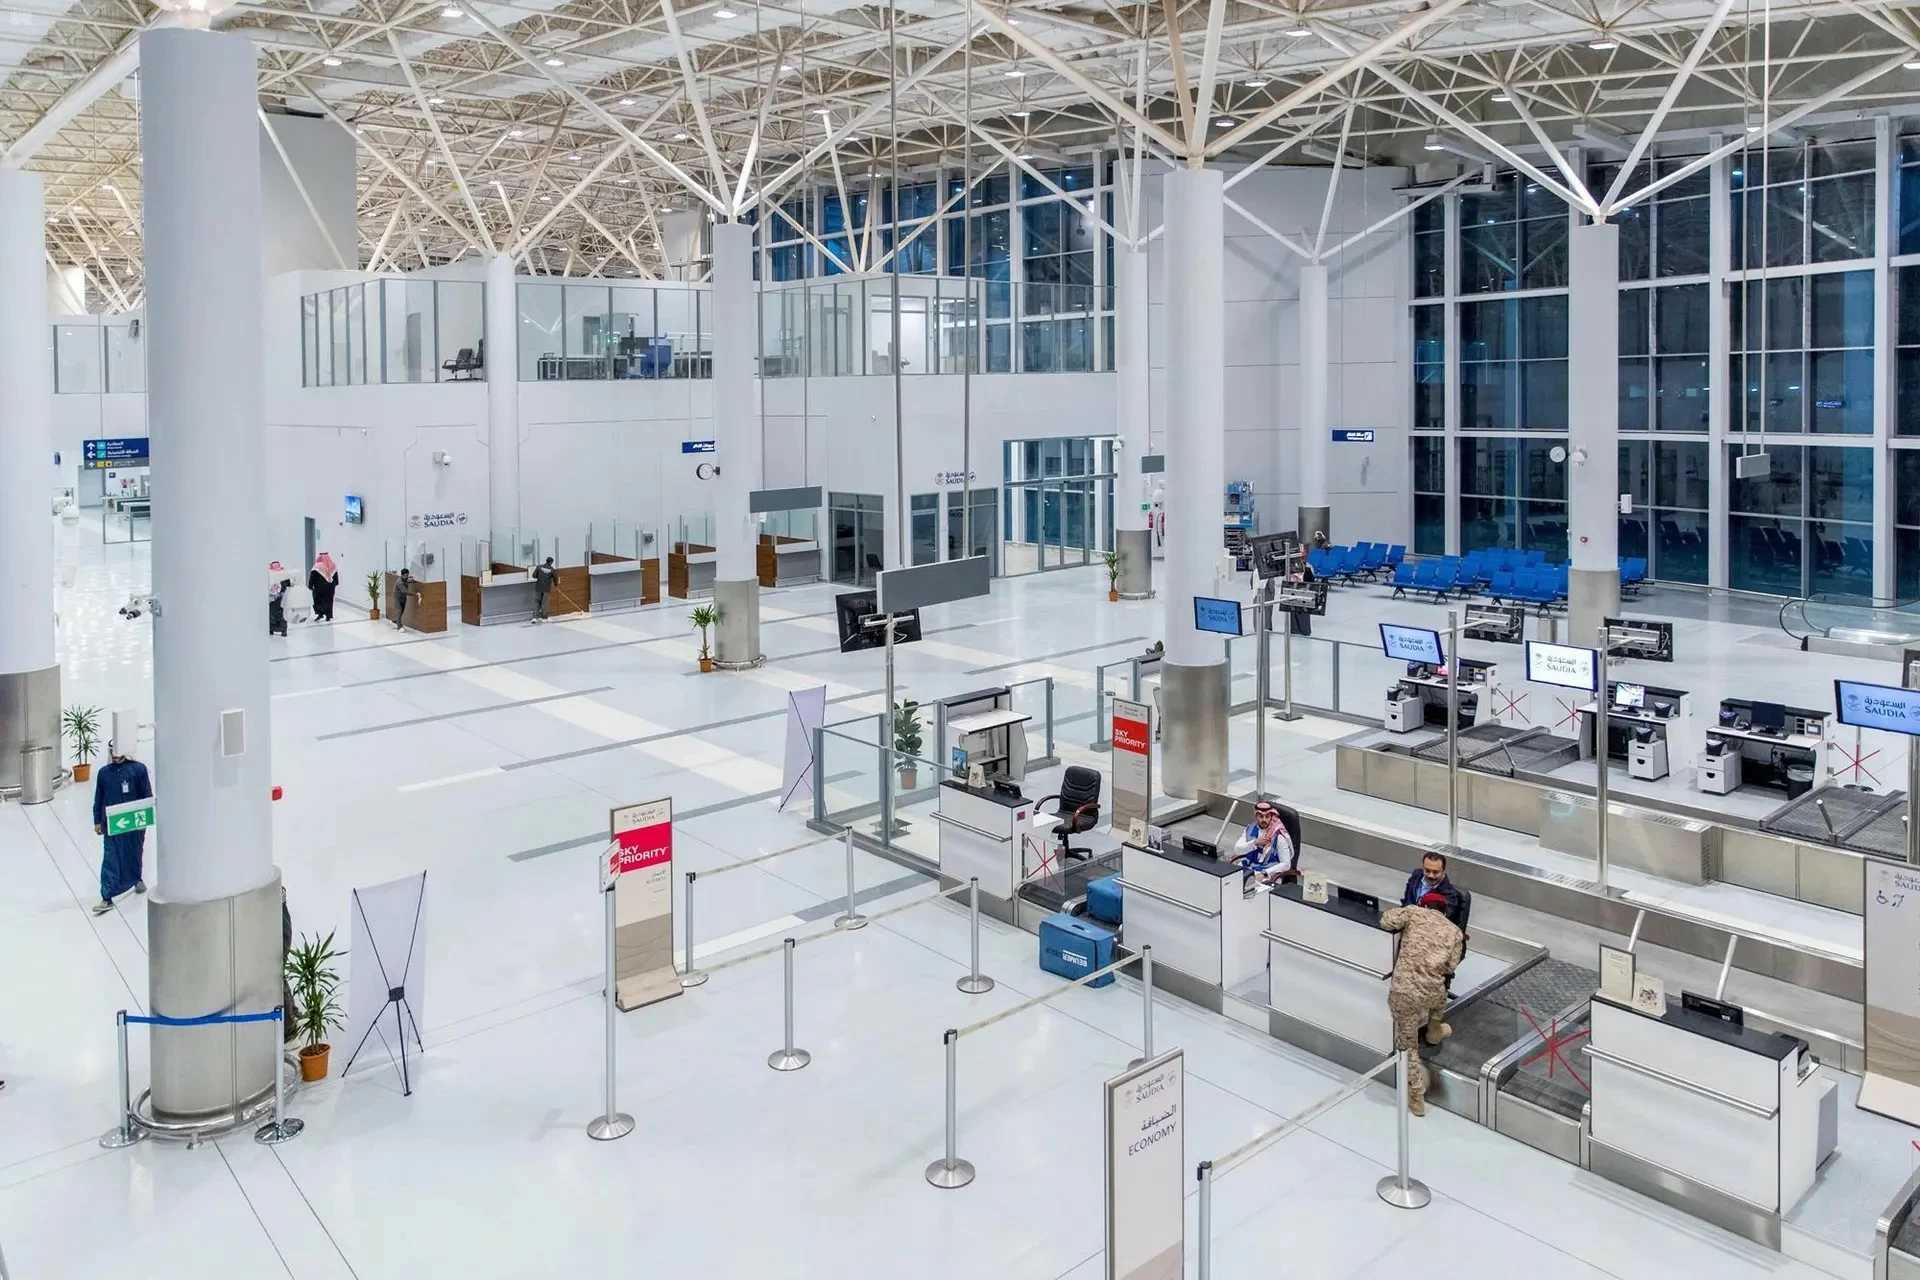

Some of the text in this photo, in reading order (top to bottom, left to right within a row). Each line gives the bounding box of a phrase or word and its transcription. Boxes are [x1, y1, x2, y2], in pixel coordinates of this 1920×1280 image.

[424, 519, 455, 528] SAUDIA
[1399, 643, 1424, 652] SAUDIA
[1546, 664, 1577, 674] SAUDIA
[1864, 696, 1906, 710] السعودية
[1864, 706, 1906, 719] SAUDIA
[1114, 728, 1129, 738] SKY
[1114, 735, 1146, 749] PRIORITY
[632, 815, 656, 825] SAUDIA
[619, 847, 667, 864] PRIORITY
[620, 844, 640, 857] SKY
[1895, 881, 1920, 892] SAUD
[1136, 1084, 1165, 1104] SAUDIA
[1141, 1103, 1177, 1131] الضيافة
[1128, 1121, 1177, 1157] ECONOMY
